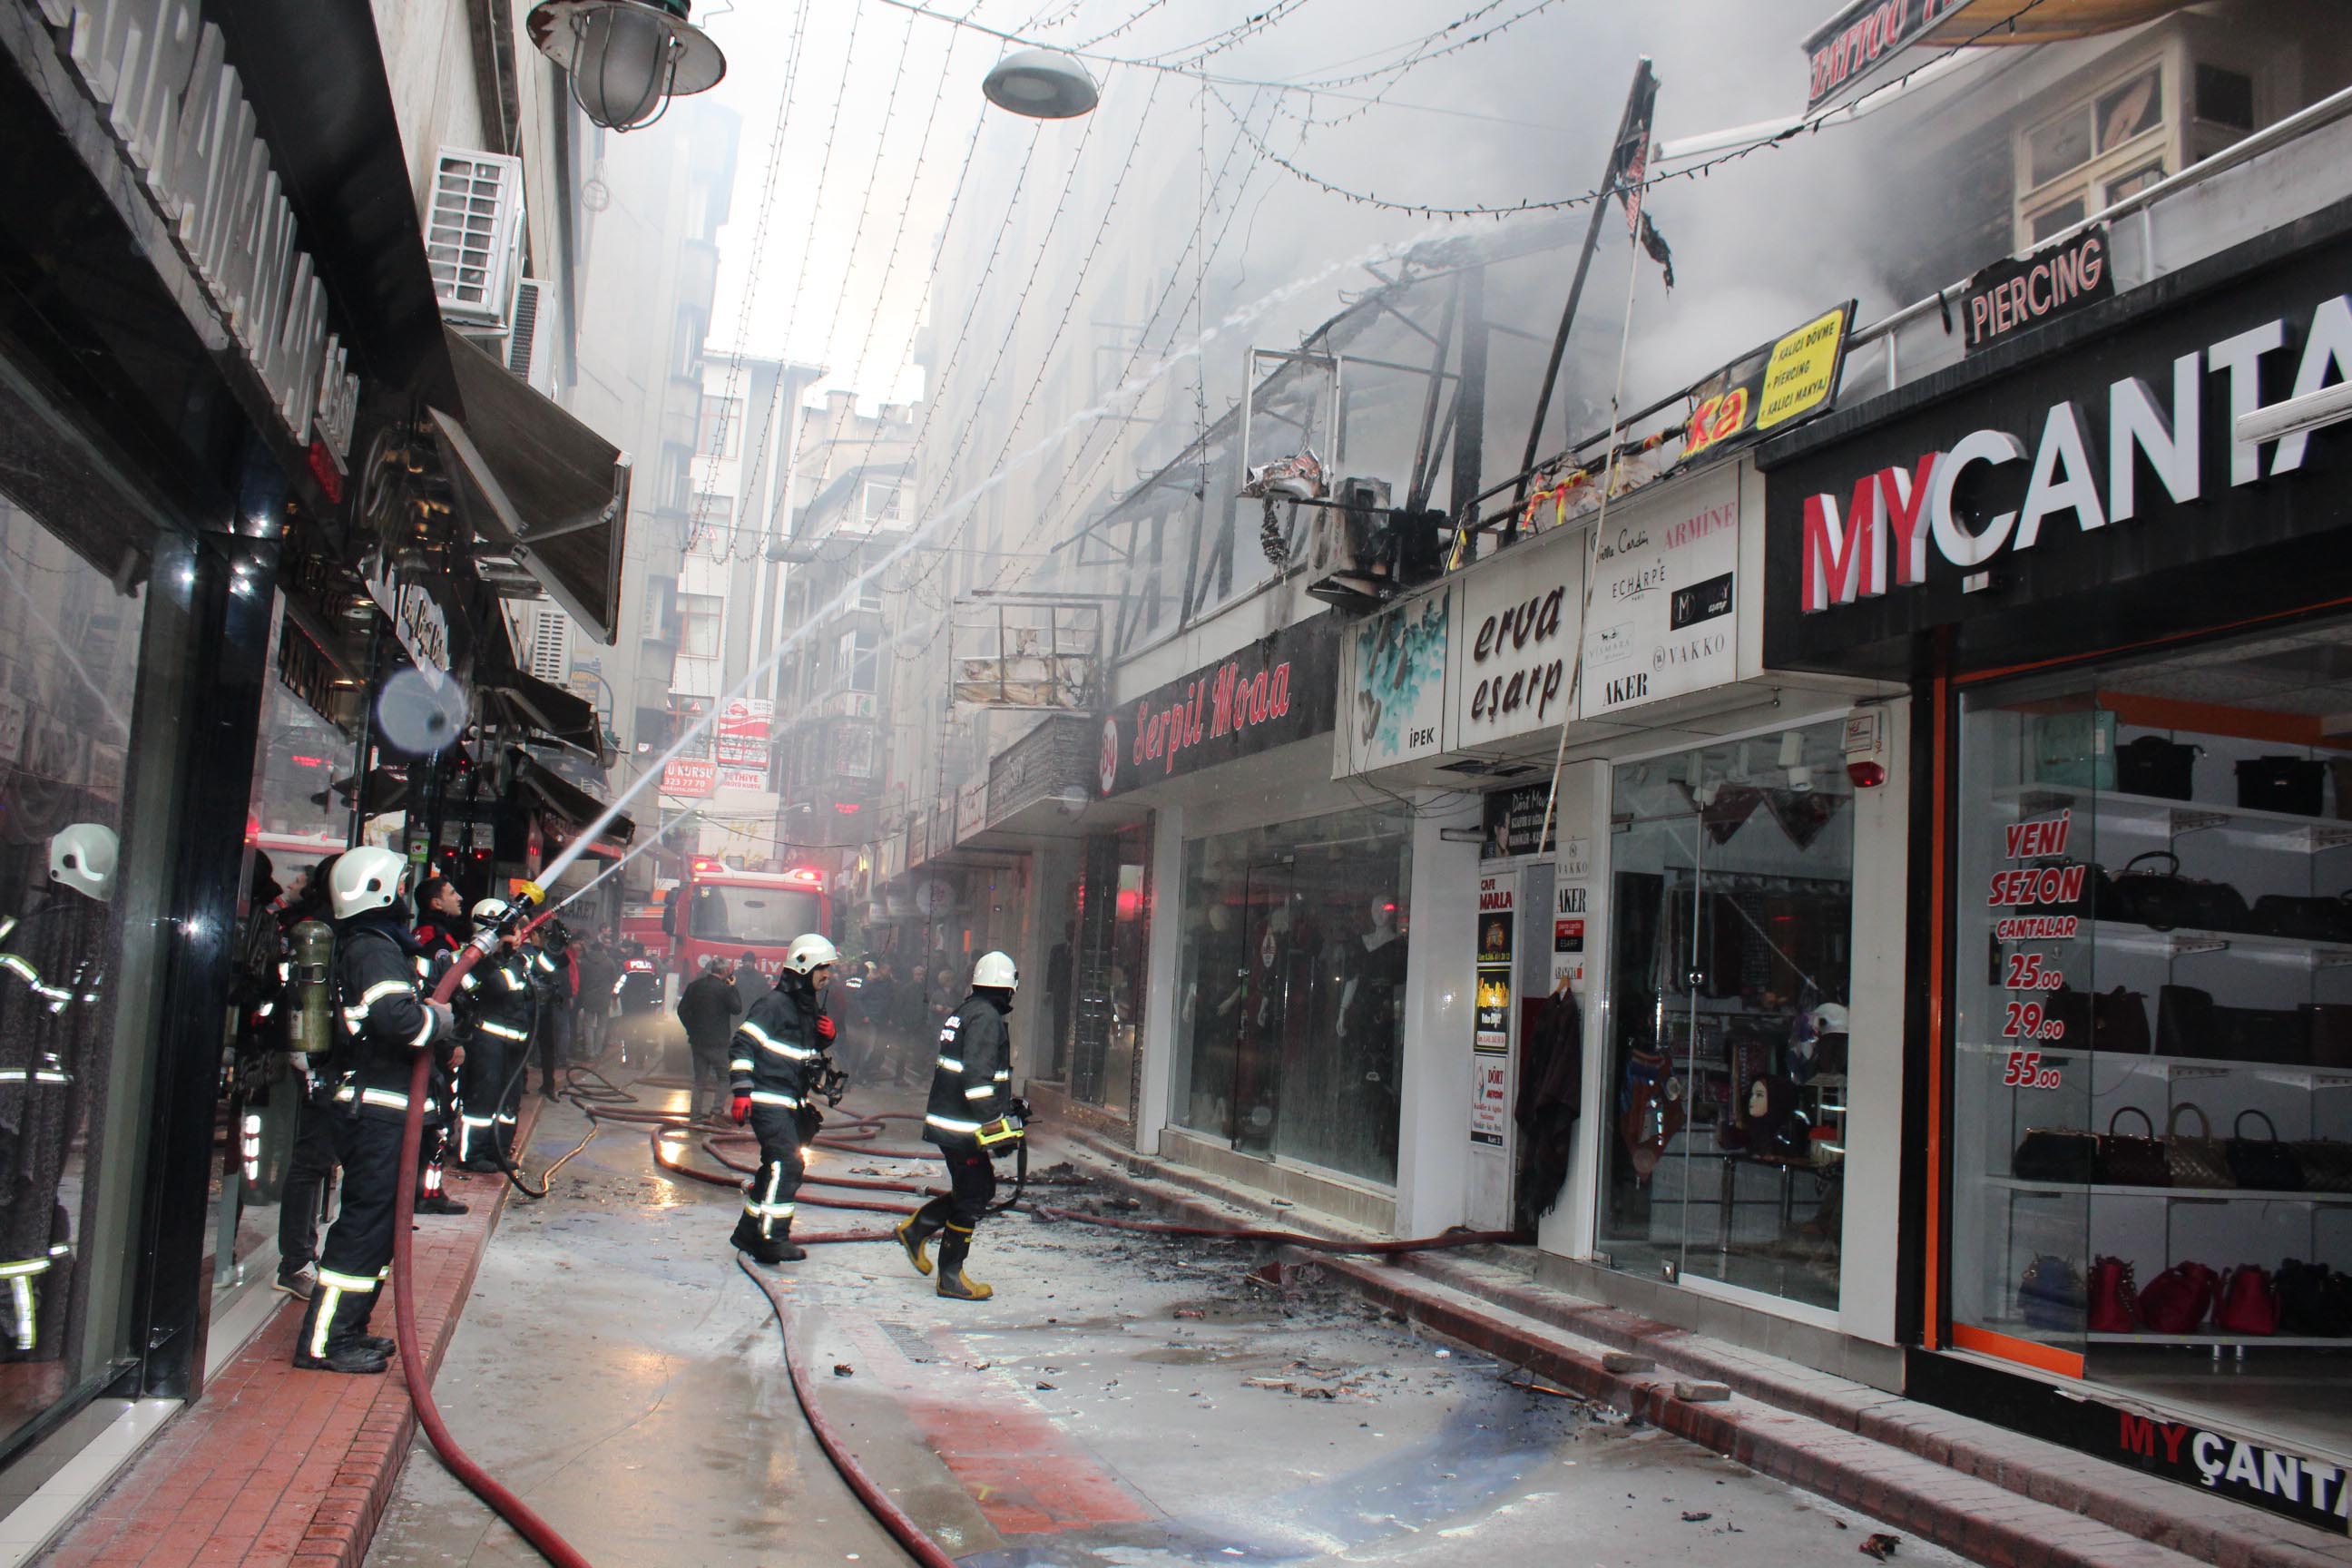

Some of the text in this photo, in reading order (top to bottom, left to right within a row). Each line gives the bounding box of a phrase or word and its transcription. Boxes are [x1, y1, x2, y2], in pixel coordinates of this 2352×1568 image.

[1972, 237, 2103, 344] PIERCING
[1779, 321, 1836, 361] KALICI DÖVME
[1767, 376, 1829, 414] KALICI MAKYAJ
[1473, 585, 1565, 662] erva
[1670, 633, 1725, 665] VAKKO
[1471, 659, 1563, 724] eşarp
[1602, 672, 1648, 706] AKER
[1132, 678, 1206, 775] Serpil
[1408, 726, 1435, 750] İPEK
[2005, 807, 2071, 859] YENİ
[1481, 878, 1496, 890] CAFE
[1558, 862, 1587, 875] VAKKO
[1987, 864, 2085, 906] SEZON
[1480, 891, 1513, 910] MARLA
[1556, 887, 1586, 913] AKER
[1996, 915, 2078, 945] ÇANTALAR
[2006, 954, 2063, 991] 25.00
[2003, 1002, 2064, 1040] 29.90
[2003, 1052, 2062, 1089] 55.00
